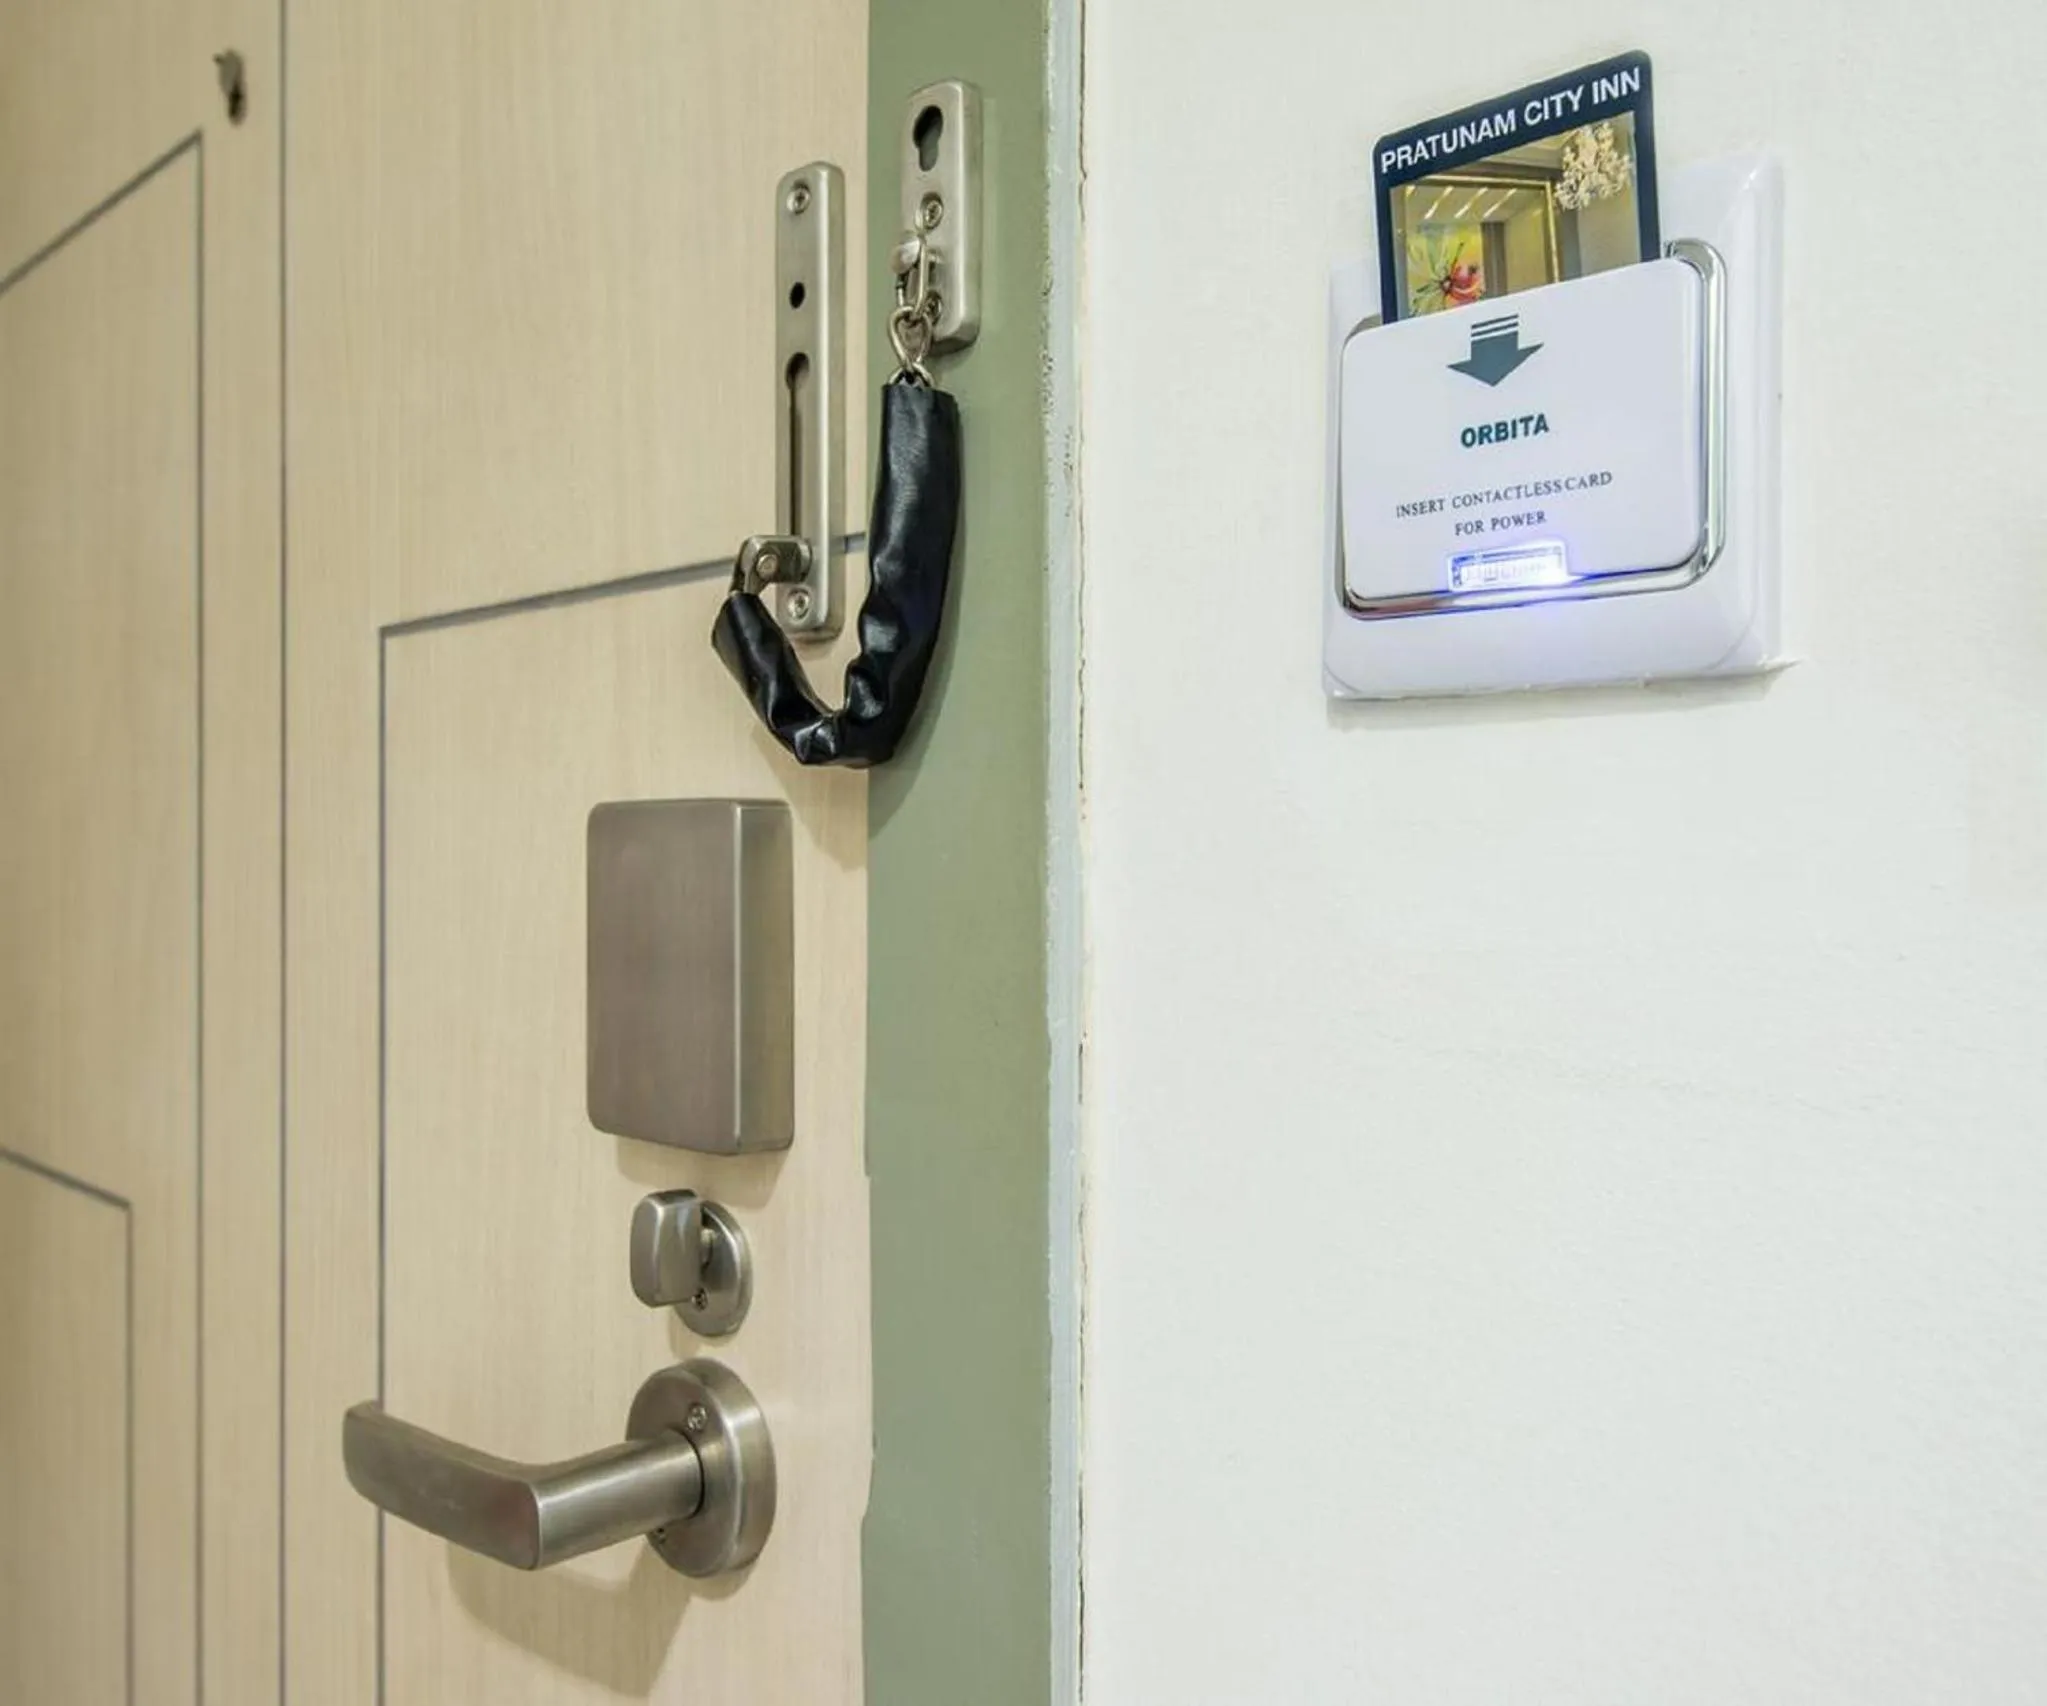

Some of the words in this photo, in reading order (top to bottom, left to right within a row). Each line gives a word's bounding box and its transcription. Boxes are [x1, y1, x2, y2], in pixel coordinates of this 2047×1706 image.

[1381, 109, 1517, 173] PRATUNAM
[1523, 86, 1584, 127] CITY
[1591, 67, 1640, 105] INN
[1460, 413, 1550, 448] ORBITA
[1396, 499, 1445, 518] INSERT
[1452, 481, 1562, 509] CONTACTLESS
[1565, 471, 1613, 491] CARD
[1454, 521, 1485, 536] FOR
[1491, 510, 1547, 531] POWER
